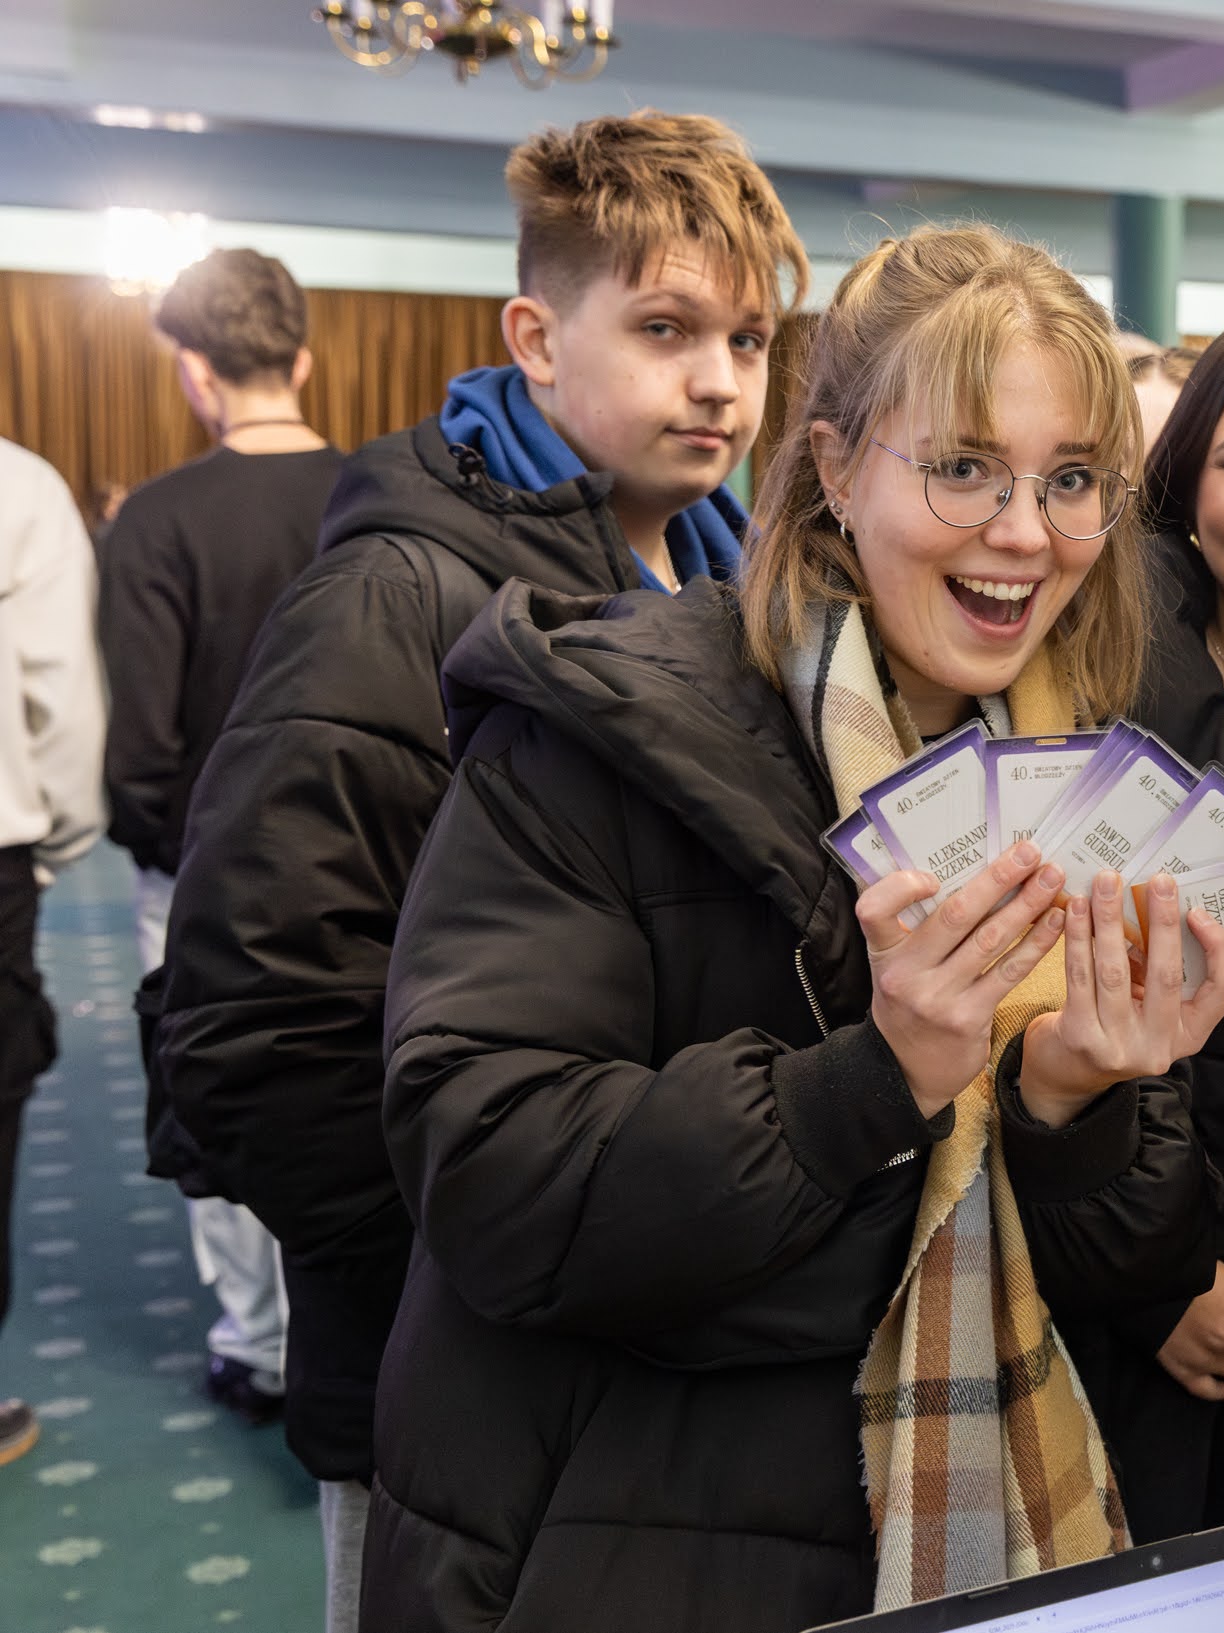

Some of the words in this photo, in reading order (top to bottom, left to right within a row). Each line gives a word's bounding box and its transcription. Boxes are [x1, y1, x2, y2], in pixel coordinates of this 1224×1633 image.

[1010, 765, 1033, 781] 40.
[1138, 774, 1157, 796] 40.
[896, 797, 919, 815] 40.
[927, 821, 988, 870] ALEKSAND
[1083, 833, 1128, 874] GURGUL
[1094, 819, 1132, 855] DAWID
[933, 848, 984, 883] RZEPKA
[1164, 855, 1192, 874] JUS
[1201, 892, 1224, 926] JEŻY
